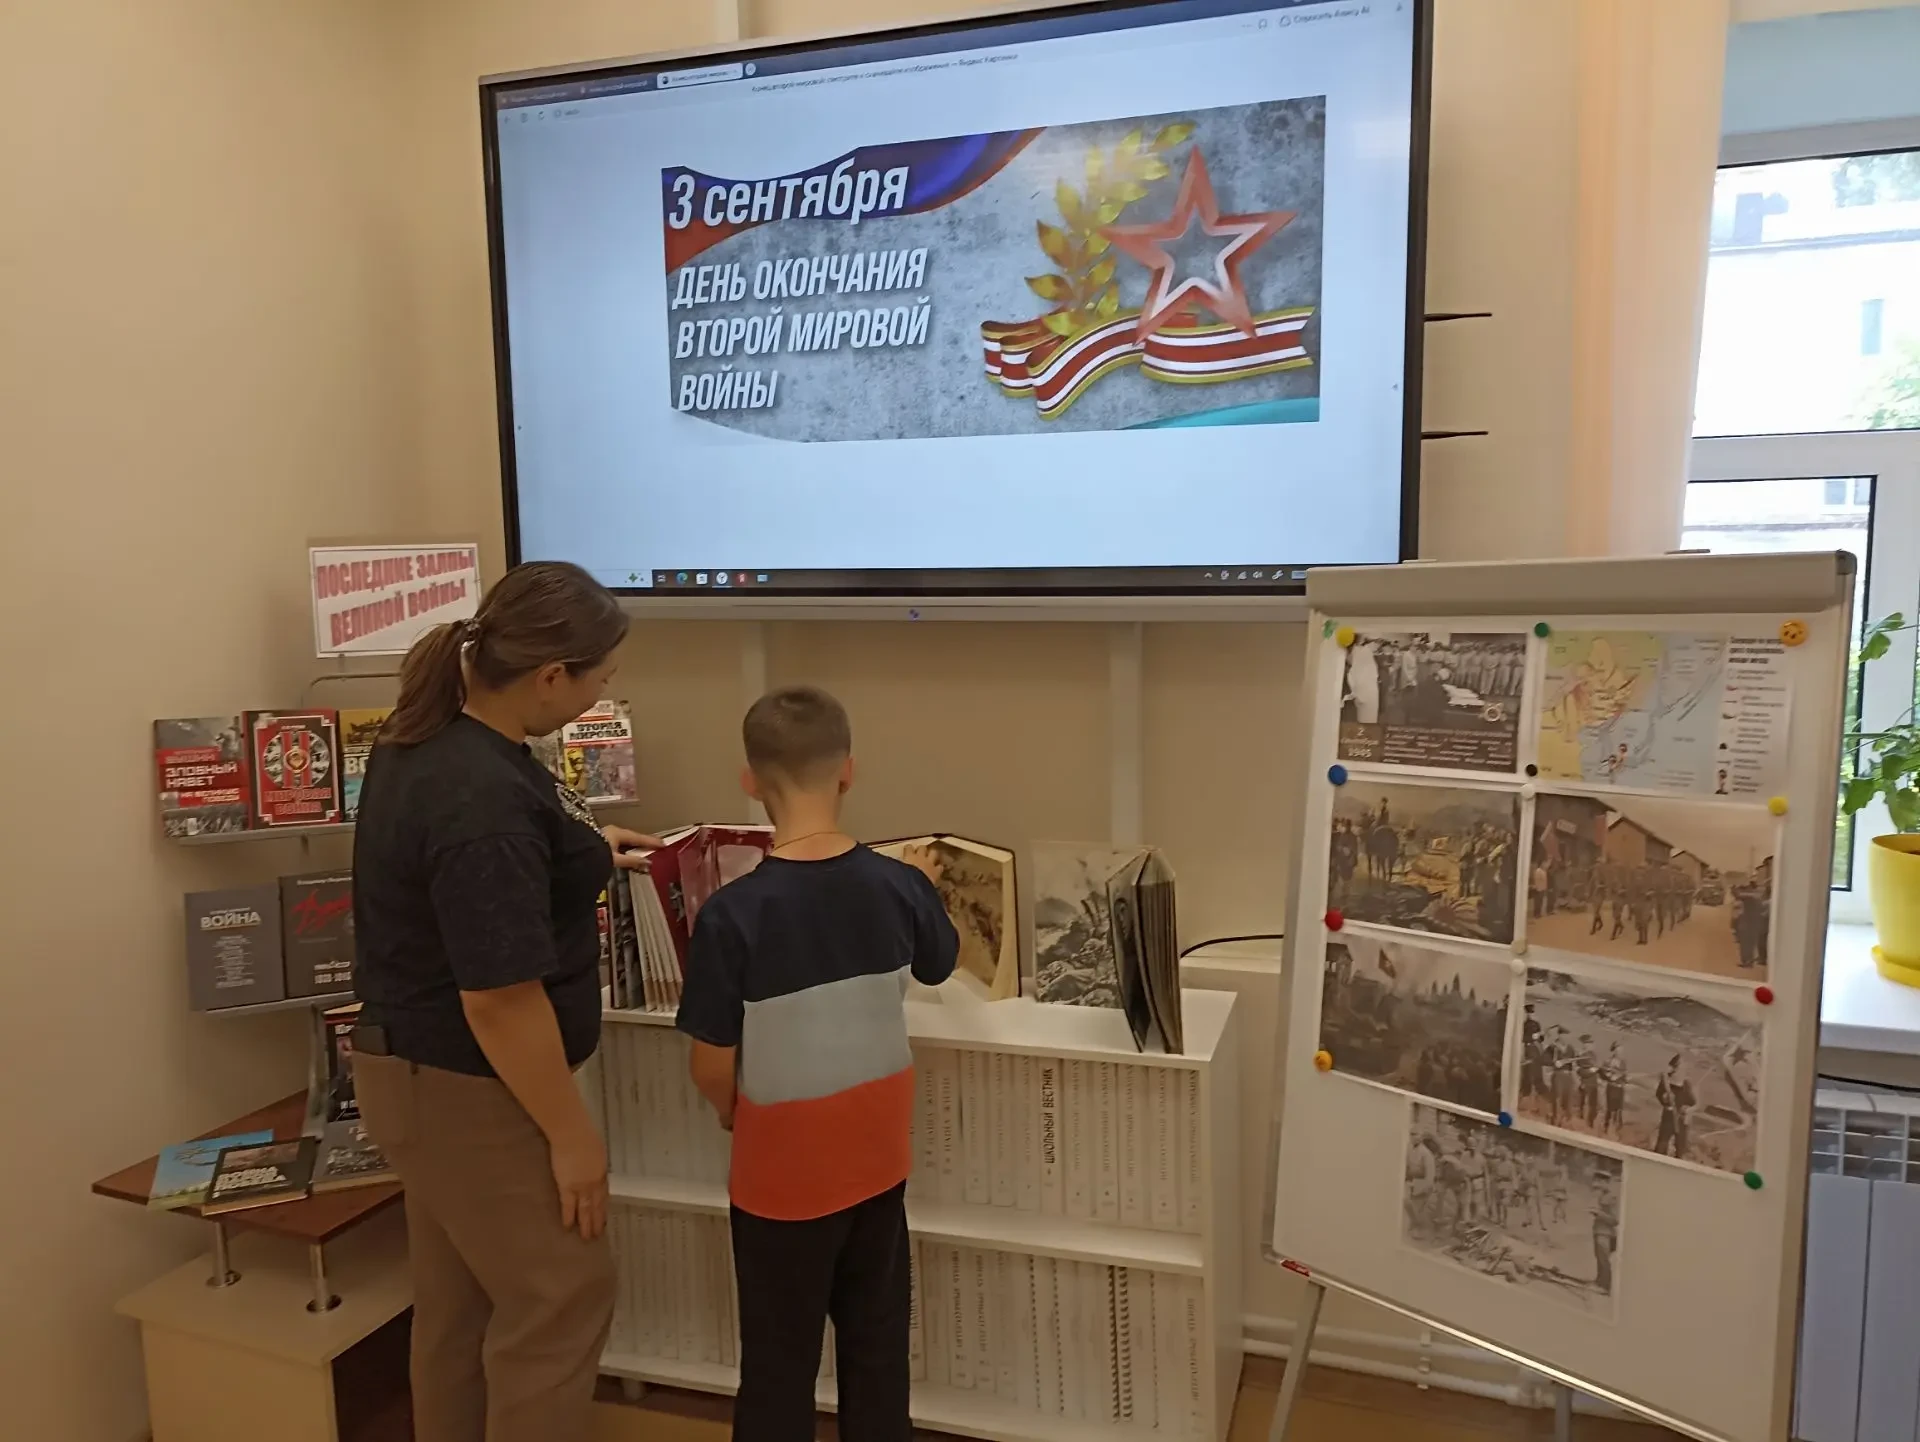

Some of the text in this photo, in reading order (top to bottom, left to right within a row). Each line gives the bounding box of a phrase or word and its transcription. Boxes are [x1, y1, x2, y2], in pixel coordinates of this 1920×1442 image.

[669, 157, 910, 230] 3 сентября
[672, 248, 928, 310] ДЕНЬ ОКОНЧАНИЯ
[675, 296, 931, 359] ВТОРОЙ МИРОВОЙ
[678, 364, 778, 412] ВОЙНЫ
[317, 549, 475, 600] ПОСЛЕДНИЕ ЗАЛПЫ
[331, 578, 466, 648] ВЕЛИКОЙ ВОЙНЫ
[569, 729, 628, 739] МИРОВАЯ
[577, 722, 622, 731] ВТОРАЯ
[165, 761, 238, 778] ЗЛОБНЫЙ
[166, 775, 215, 788] НАВЕТ
[201, 911, 261, 928] ВОЙНА
[1041, 1067, 1056, 1165] ШКОЛЬНЫЙ ВЕСТНИК
